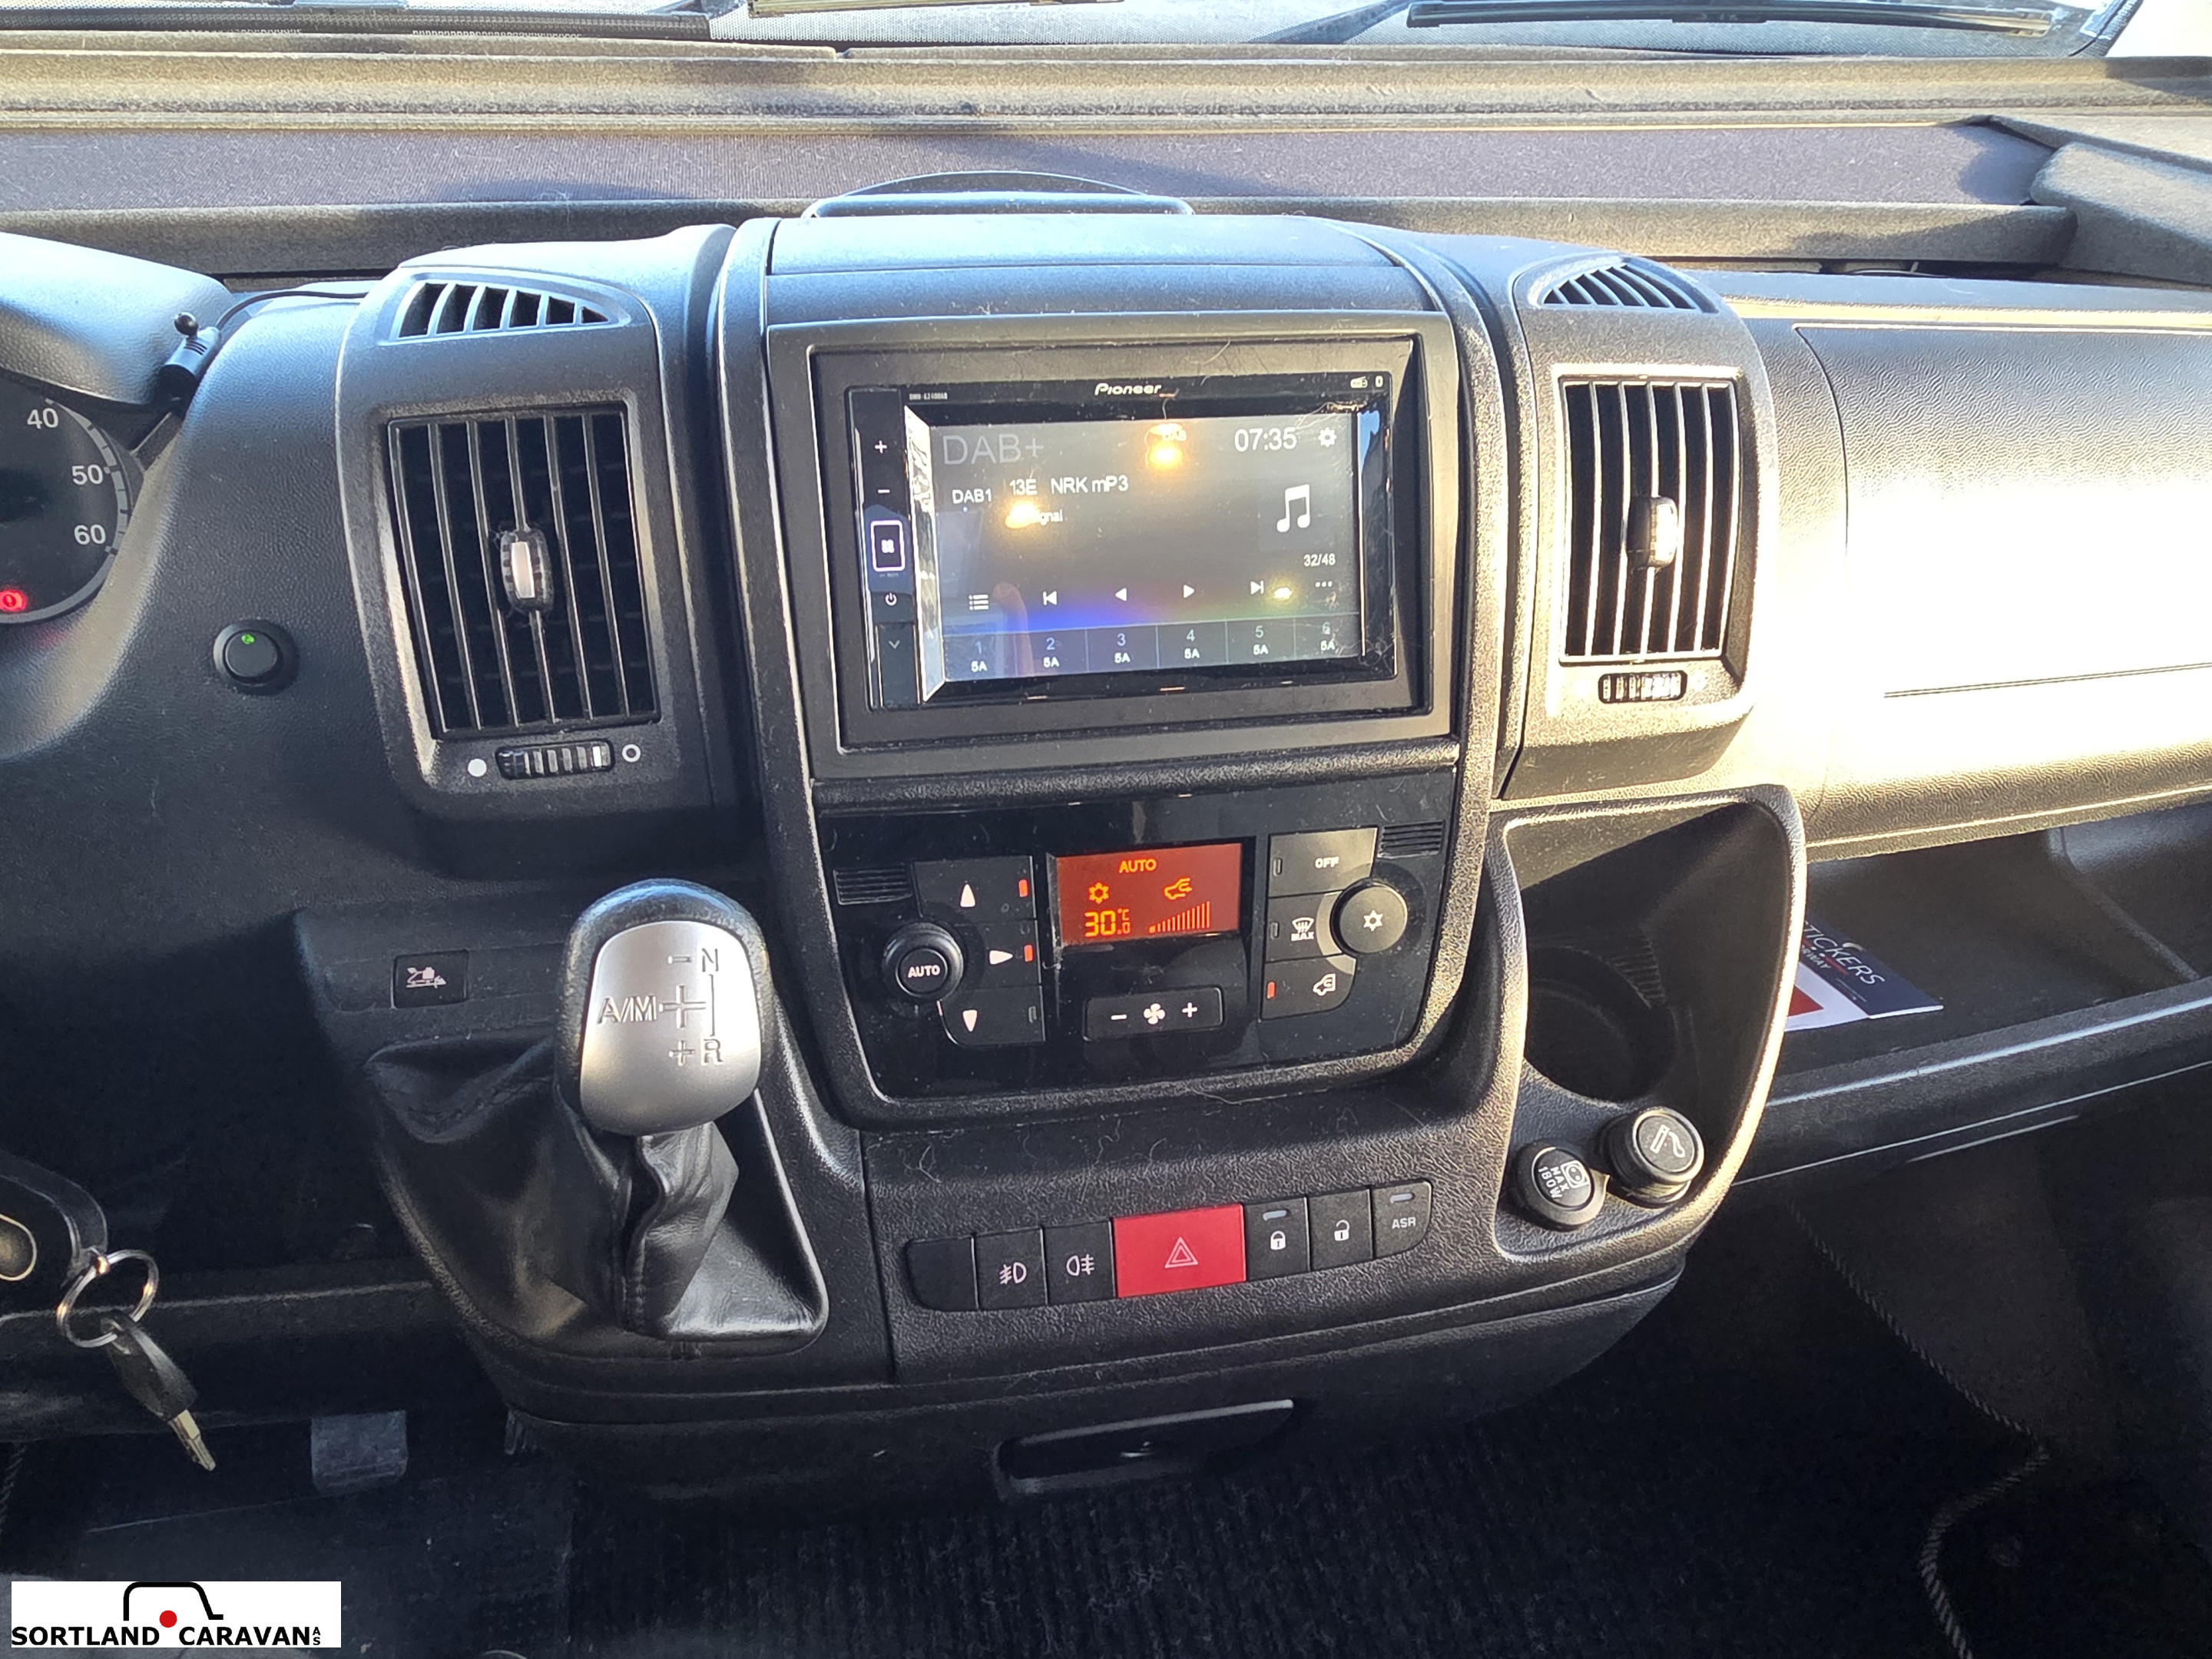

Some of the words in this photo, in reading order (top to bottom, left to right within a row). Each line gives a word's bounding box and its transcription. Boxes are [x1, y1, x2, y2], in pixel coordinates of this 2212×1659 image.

[1094, 382, 1162, 396] Pioneer
[27, 407, 59, 429] 40
[1234, 427, 1297, 452] 07:35
[943, 433, 1044, 465] DAB+
[71, 464, 103, 485] 50
[1009, 478, 1038, 495] 13E
[1051, 477, 1088, 495] NRK
[1092, 475, 1129, 492] mP3
[952, 488, 992, 504] DAB1
[74, 524, 106, 545] 60
[1303, 553, 1336, 567] 32/48
[1187, 629, 1195, 642] 4
[1256, 625, 1264, 638] 5
[1047, 637, 1055, 651] 2
[1118, 634, 1126, 646] 3
[1119, 859, 1157, 873] AUTO
[1315, 856, 1339, 869] OFF
[1291, 931, 1314, 941] MAX
[701, 948, 719, 972] N
[1803, 921, 1886, 985] TICKERS
[908, 965, 941, 978] AUTO
[597, 995, 657, 1024] A/M
[700, 1038, 724, 1066] R
[1550, 1166, 1570, 1191] MAX
[1392, 1216, 1416, 1230] ASR
